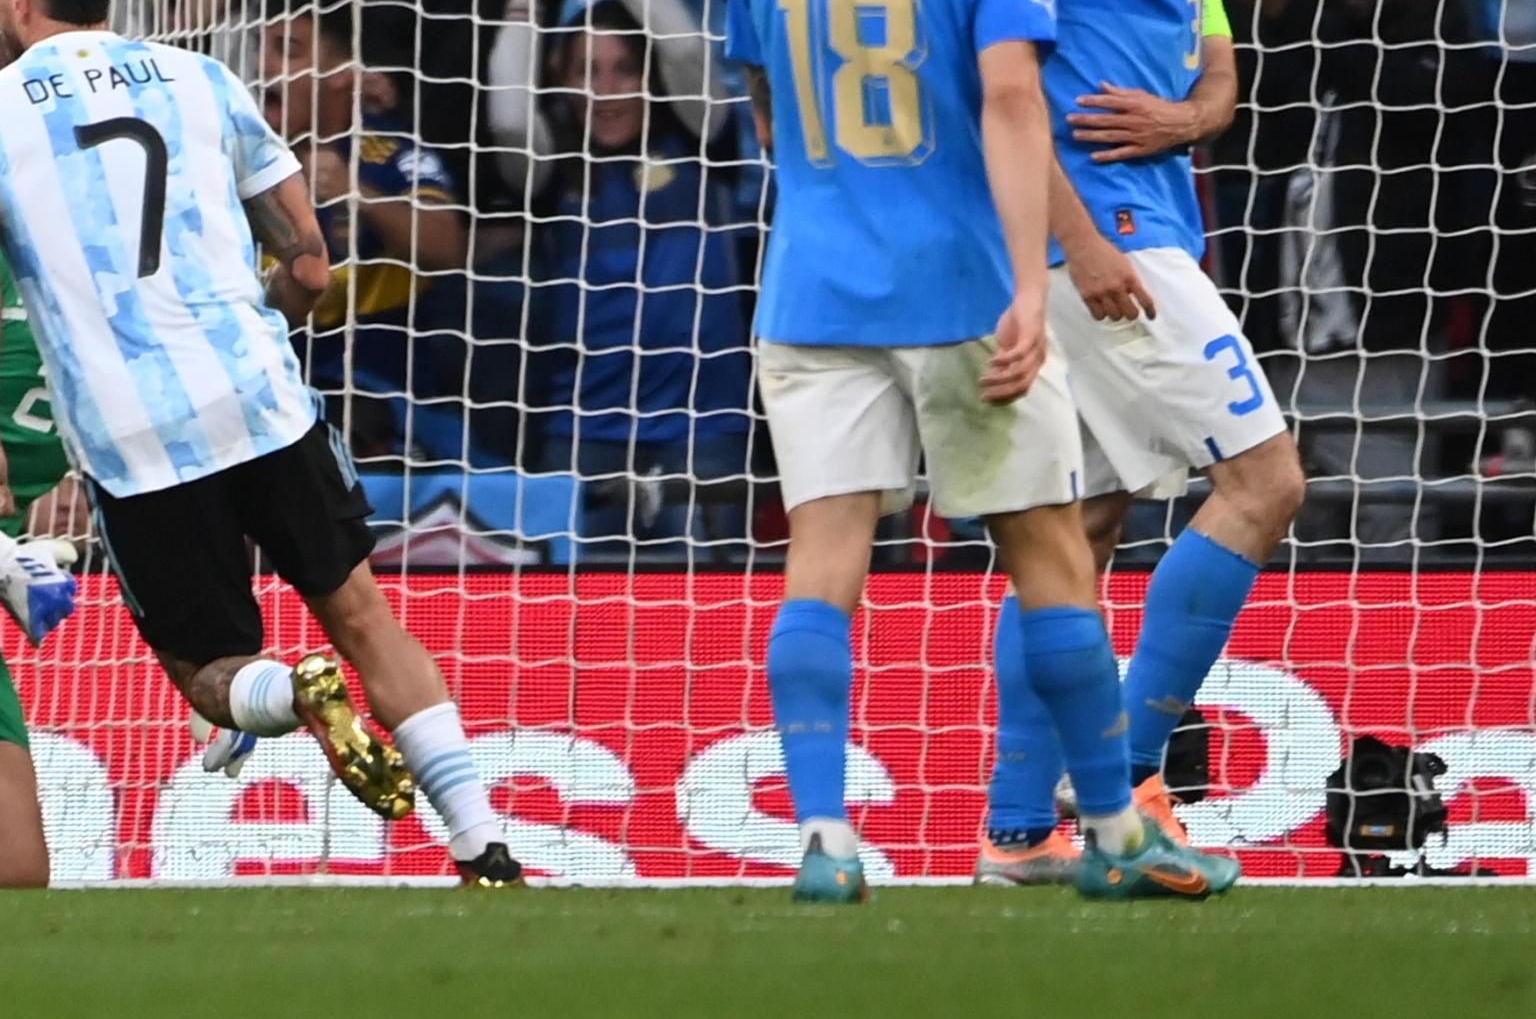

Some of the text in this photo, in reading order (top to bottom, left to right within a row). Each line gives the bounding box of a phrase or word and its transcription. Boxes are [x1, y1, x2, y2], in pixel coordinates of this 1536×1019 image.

[22, 58, 176, 105] DE PAUL
[72, 116, 169, 280] 7
[1203, 334, 1264, 417] 3
